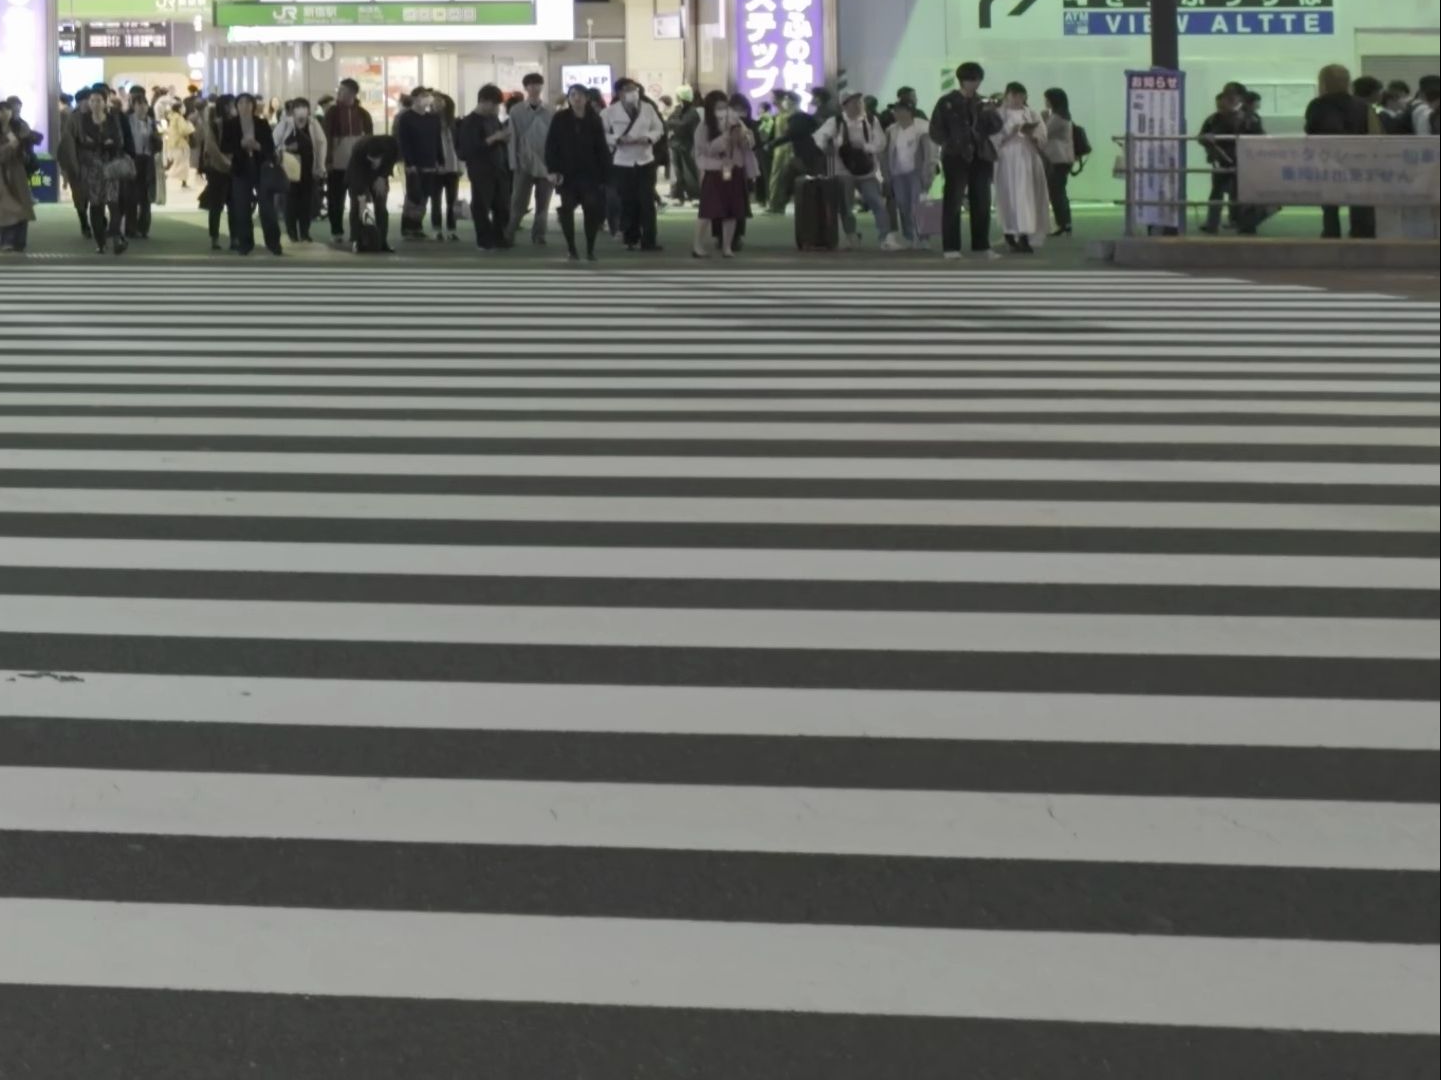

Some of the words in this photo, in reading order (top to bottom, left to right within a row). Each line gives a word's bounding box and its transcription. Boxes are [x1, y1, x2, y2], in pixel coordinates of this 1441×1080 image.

[272, 5, 298, 21] JR
[1211, 14, 1320, 33] ALTTE
[1131, 76, 1178, 89] お知らせ
